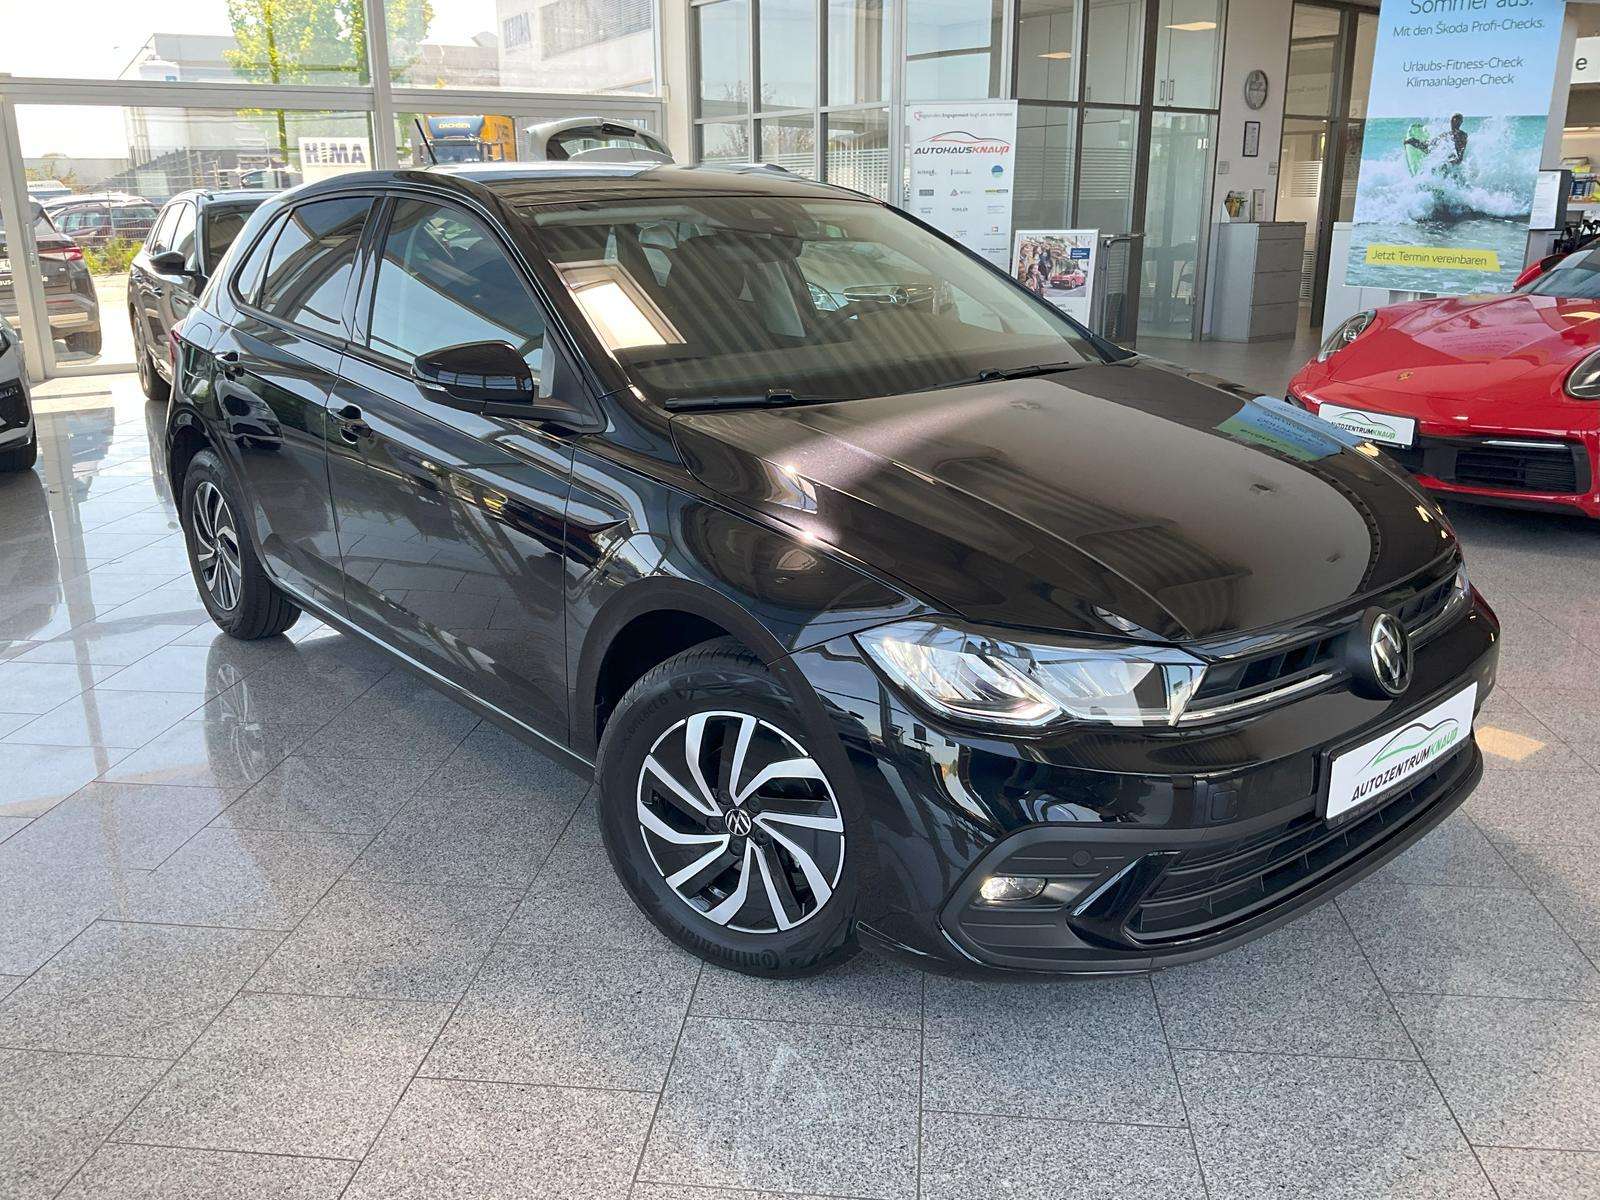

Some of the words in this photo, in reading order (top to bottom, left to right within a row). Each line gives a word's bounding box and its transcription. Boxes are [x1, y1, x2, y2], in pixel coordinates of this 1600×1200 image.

[1410, 0, 1487, 14] Sommer
[1393, 26, 1411, 37] Mit
[1413, 25, 1433, 36] den
[1436, 20, 1469, 34] Škoda
[1471, 18, 1545, 32] Profi-Checks.
[1403, 57, 1525, 72] Urlaubs-Fitness-Check
[1407, 74, 1515, 88] Klimaanlagen-Check
[1372, 250, 1396, 260] Jetzt
[1398, 251, 1430, 261] Termin
[1432, 254, 1487, 266] vereinbaren
